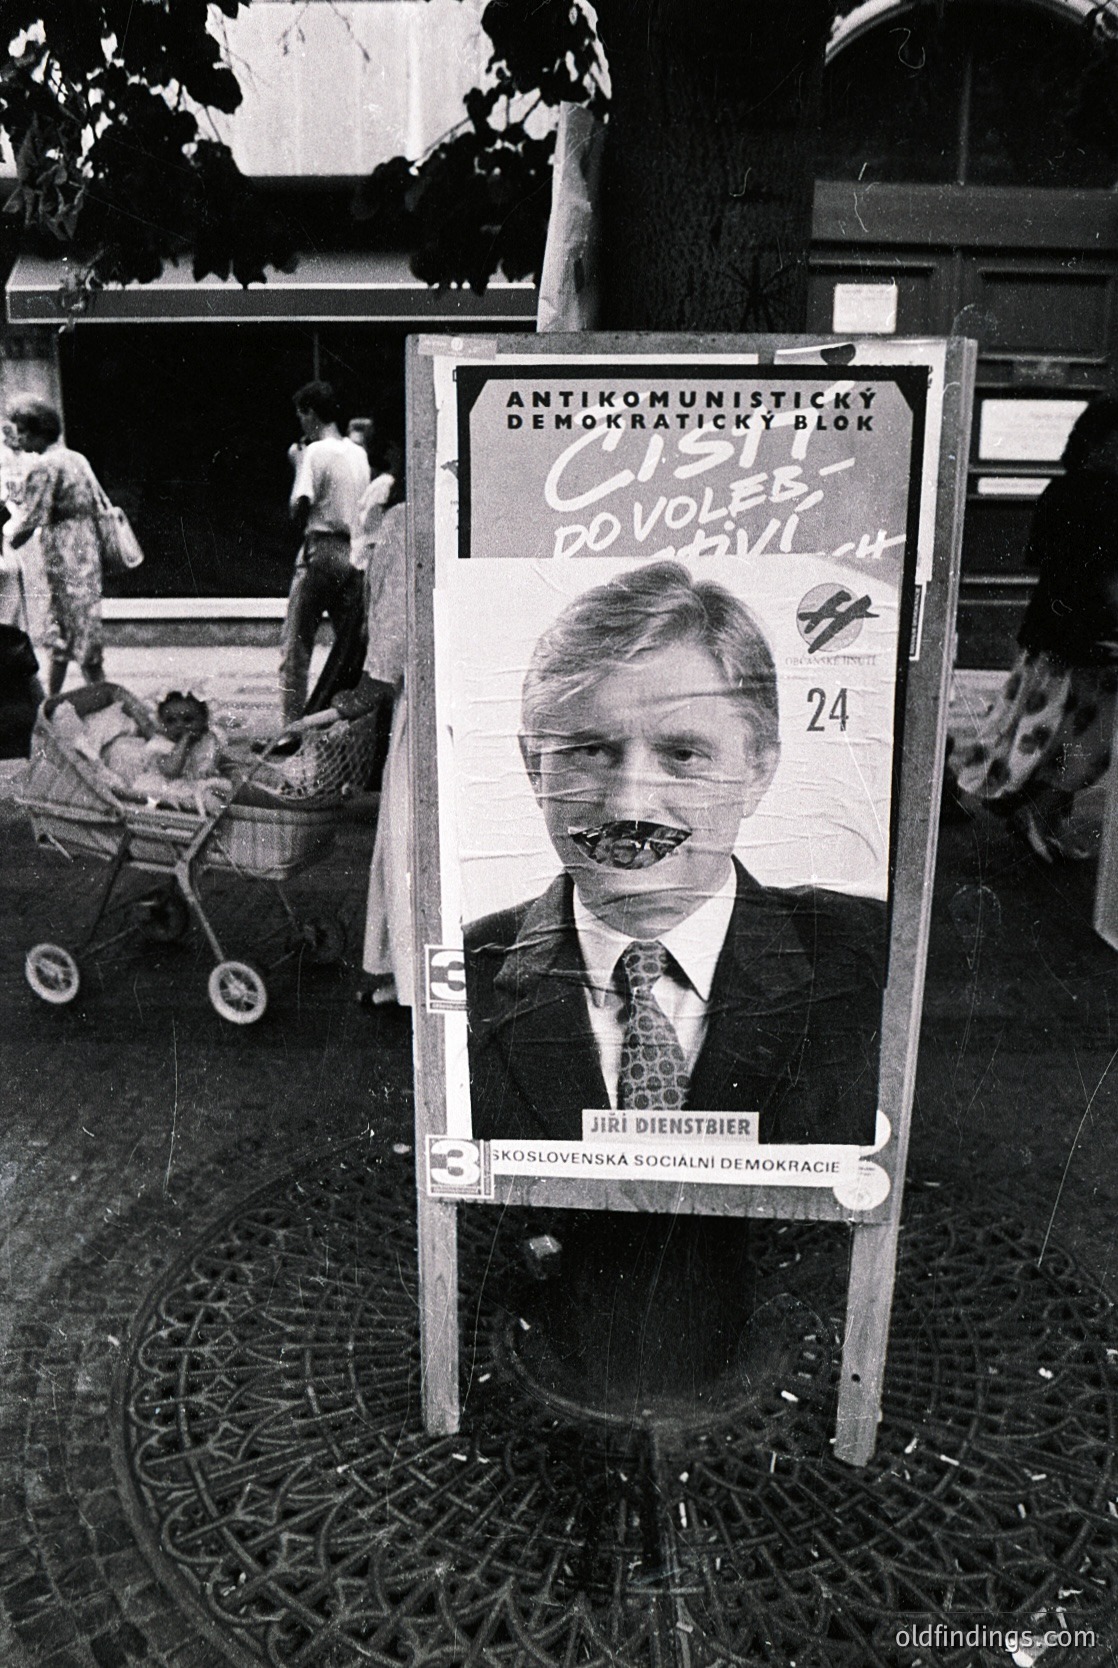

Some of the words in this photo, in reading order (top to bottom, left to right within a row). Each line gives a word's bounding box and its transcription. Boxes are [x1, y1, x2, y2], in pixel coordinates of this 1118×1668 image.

[507, 388, 876, 408] ANTIKOMUNISTICKÝ
[508, 410, 774, 430] DEMOKRATICKÝ
[794, 415, 873, 431] BLOK
[554, 512, 622, 558] DO
[806, 687, 849, 732] 24
[430, 950, 467, 1001] 3
[591, 1112, 628, 1133] JIŘÍ
[636, 1117, 751, 1136] DIENSTBIER
[430, 1140, 480, 1186] 3
[492, 1149, 629, 1166] SKOSLOVENSKÁ
[634, 1153, 715, 1169] SOCIÁLNÍ
[720, 1157, 841, 1174] DEMOKRACIE
